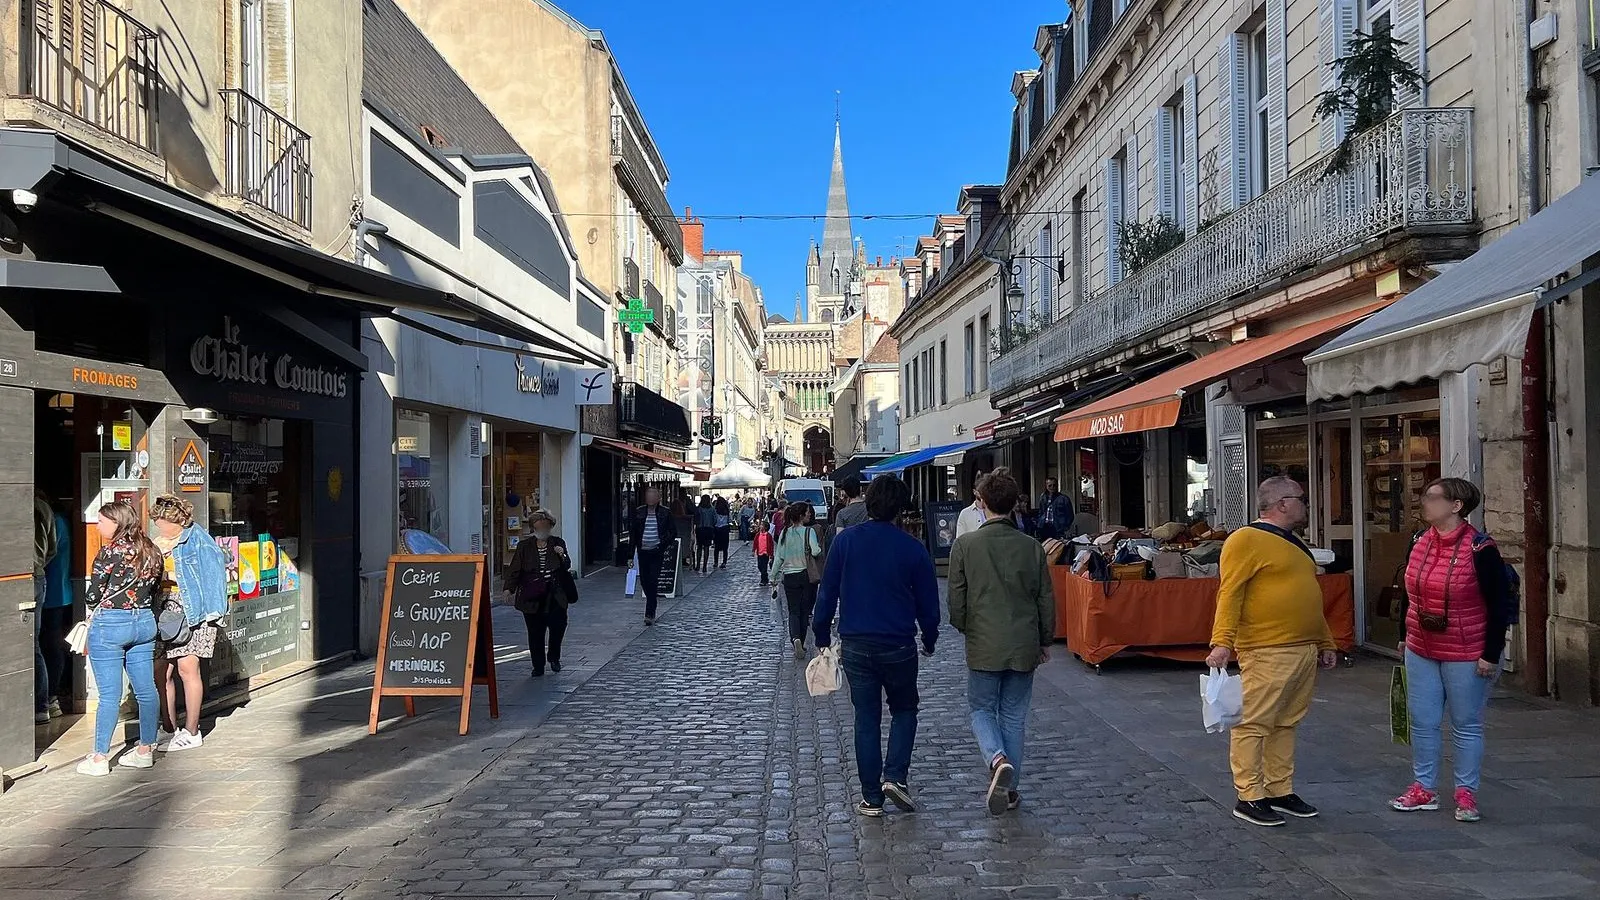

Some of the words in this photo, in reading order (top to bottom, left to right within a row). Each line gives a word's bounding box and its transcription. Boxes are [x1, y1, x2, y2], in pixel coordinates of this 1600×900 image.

[224, 315, 240, 345] le
[3, 363, 13, 373] 28
[189, 335, 269, 385] Chalet
[274, 353, 347, 398] Comtois
[72, 367, 138, 391] FROMAGES
[188, 453, 196, 463] le
[180, 463, 202, 475] Chalet
[178, 473, 205, 485] Comtois
[429, 589, 472, 599] DOUBLE
[393, 605, 405, 618] de
[389, 630, 416, 649] (Suisse)
